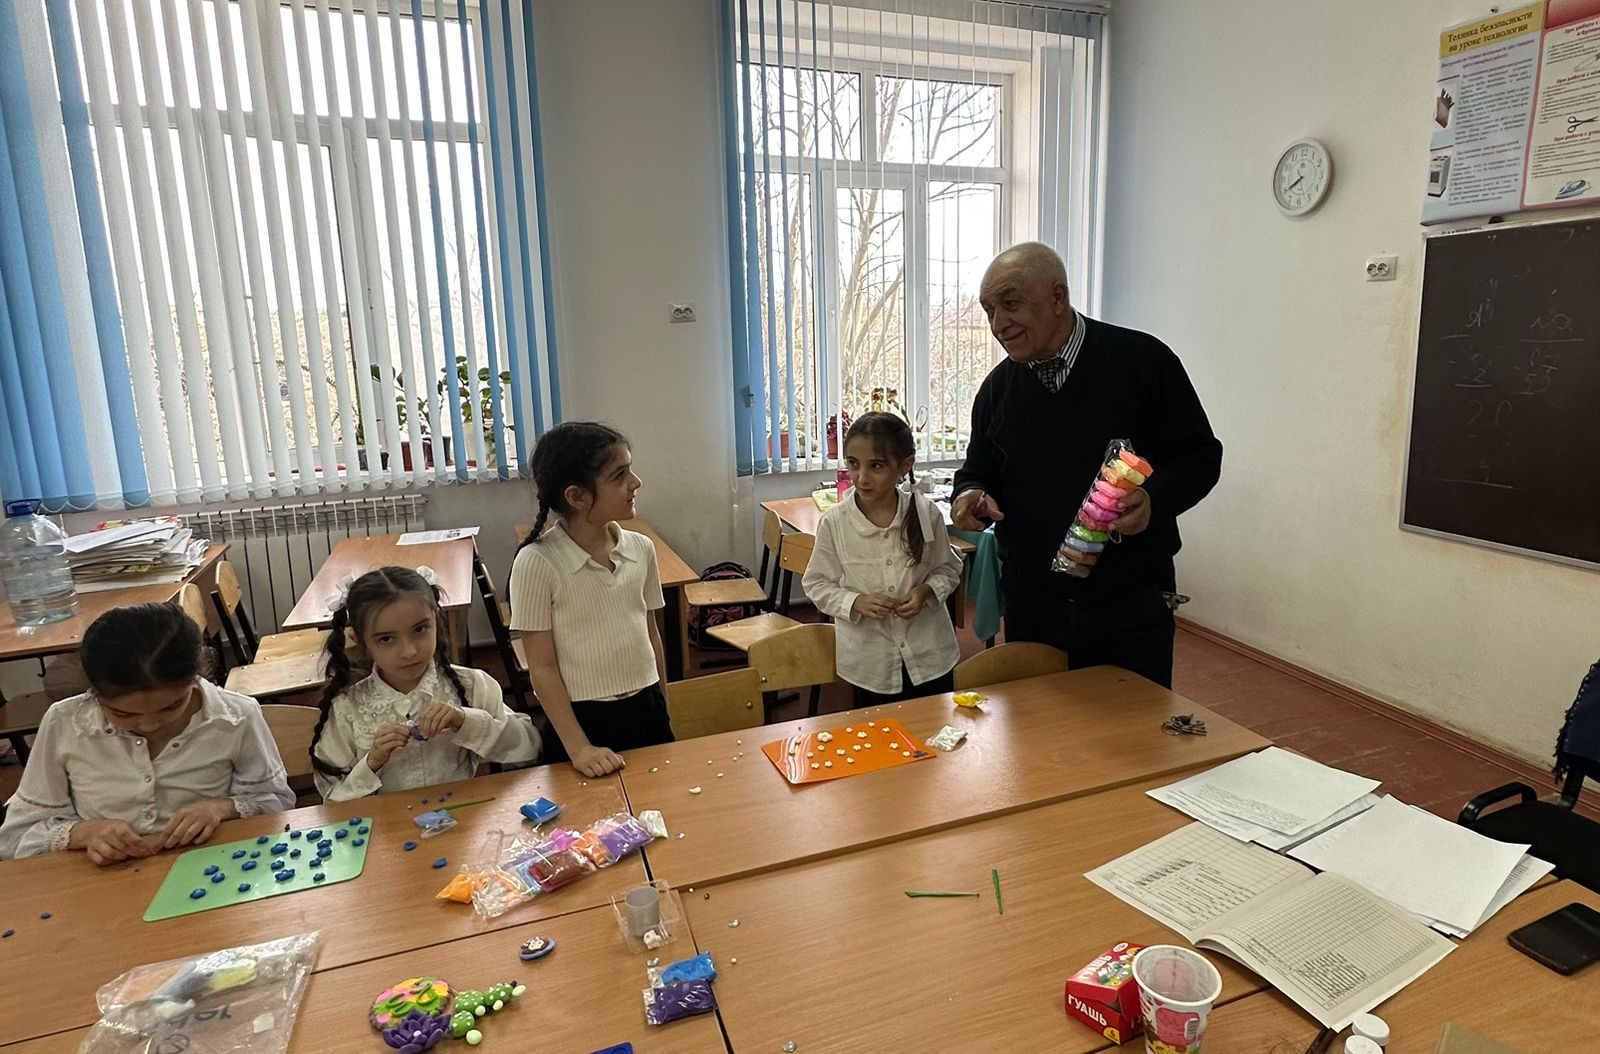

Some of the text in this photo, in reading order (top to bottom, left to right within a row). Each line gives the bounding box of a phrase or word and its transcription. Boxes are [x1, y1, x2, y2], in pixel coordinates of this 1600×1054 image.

[1448, 12, 1533, 42] Техника безопасности
[1448, 24, 1529, 52] на уроке технологии
[1077, 955, 1112, 980] ГУАШЬ
[1068, 994, 1107, 1026] ГУАШЬ
